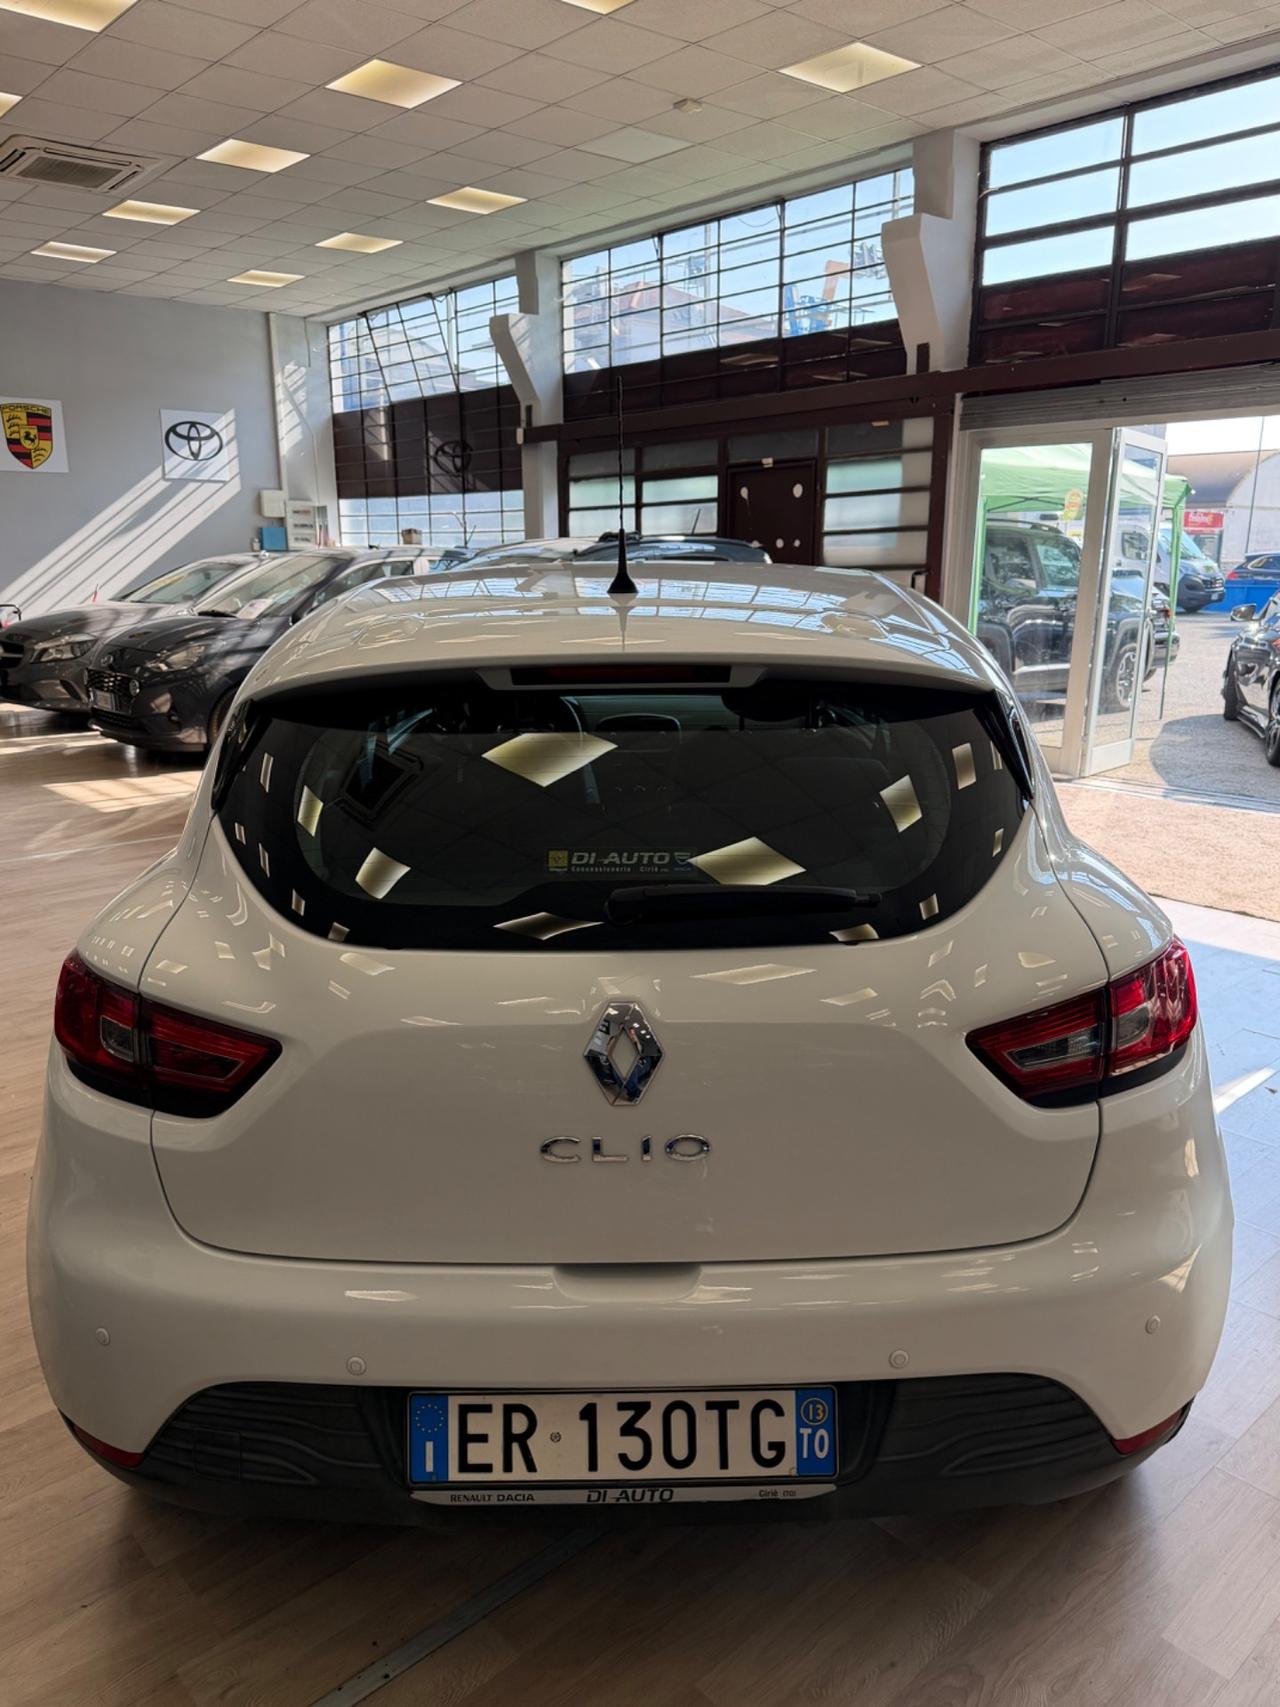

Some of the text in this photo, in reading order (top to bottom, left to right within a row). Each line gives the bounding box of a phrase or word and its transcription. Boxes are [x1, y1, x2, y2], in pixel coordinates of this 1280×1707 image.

[540, 1134, 711, 1163] CLIO
[808, 1404, 824, 1421] 13
[458, 1403, 537, 1473] ER
[800, 1428, 830, 1459] TO
[450, 1494, 492, 1503] RENAULT
[497, 1493, 535, 1502] DACIA
